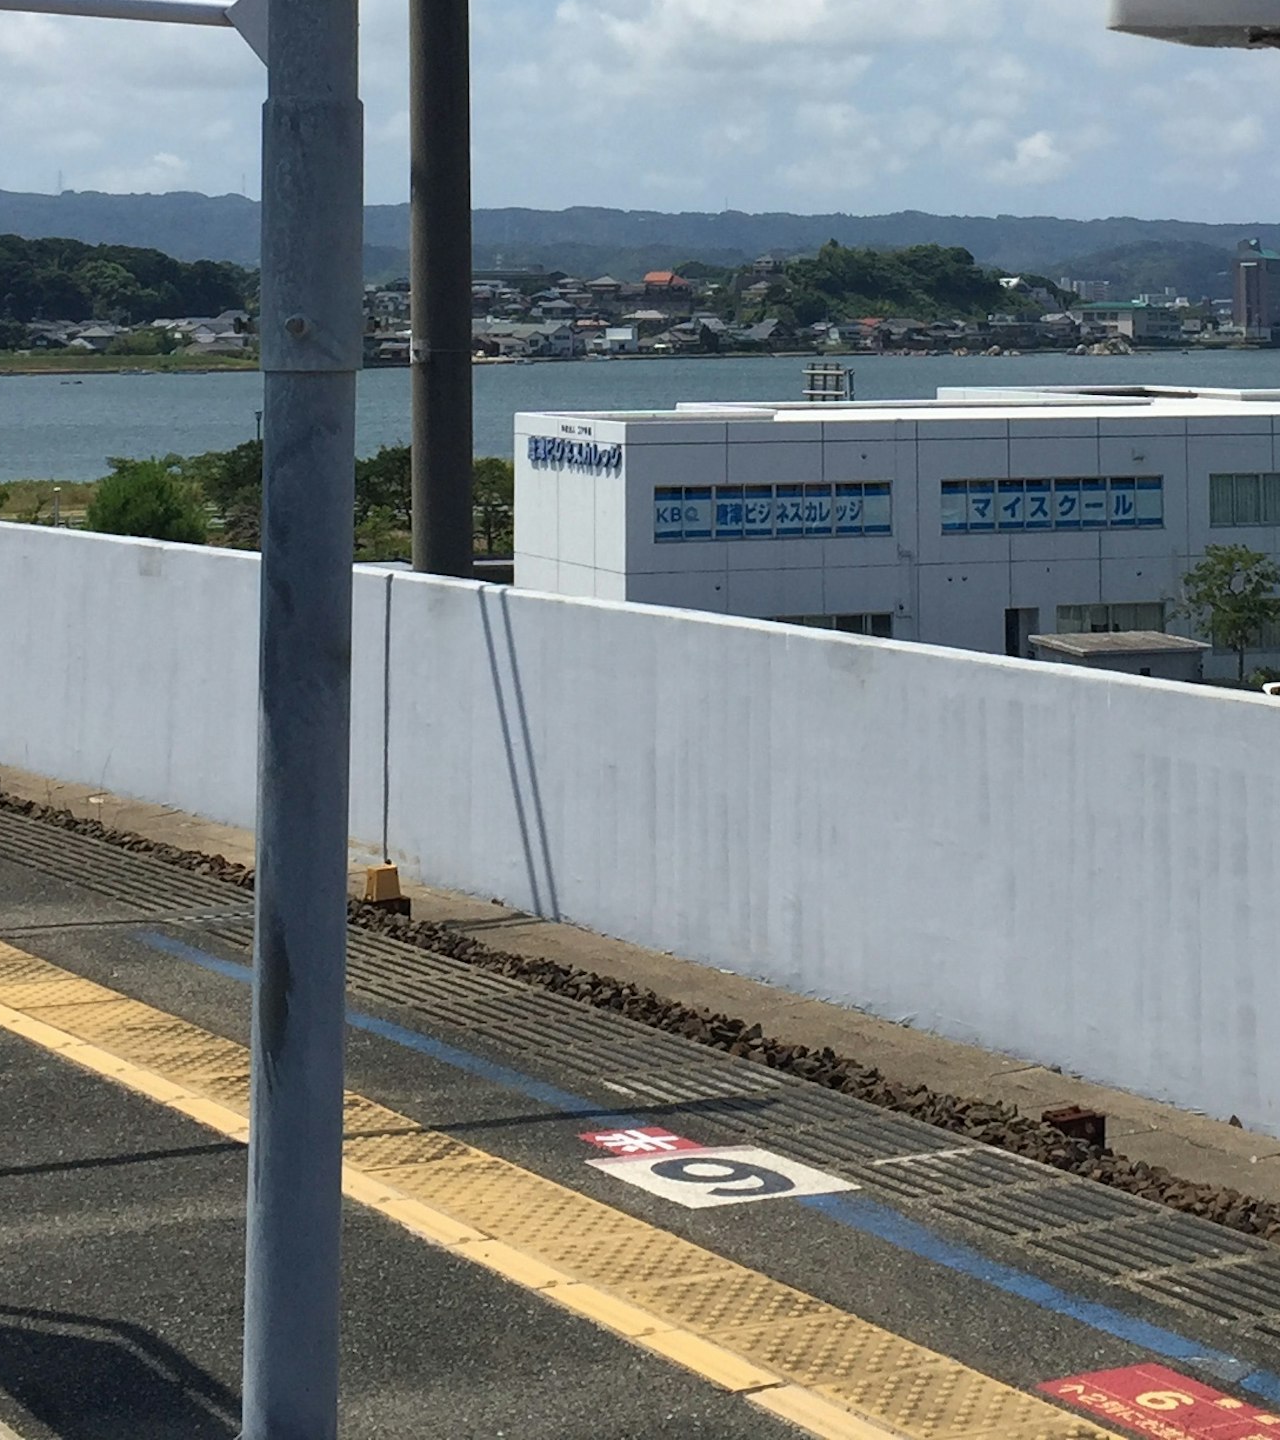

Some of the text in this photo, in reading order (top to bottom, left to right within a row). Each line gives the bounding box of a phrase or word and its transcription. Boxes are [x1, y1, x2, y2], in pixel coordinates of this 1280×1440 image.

[972, 494, 1133, 518] マイスクール
[1136, 1391, 1194, 1411] 6
